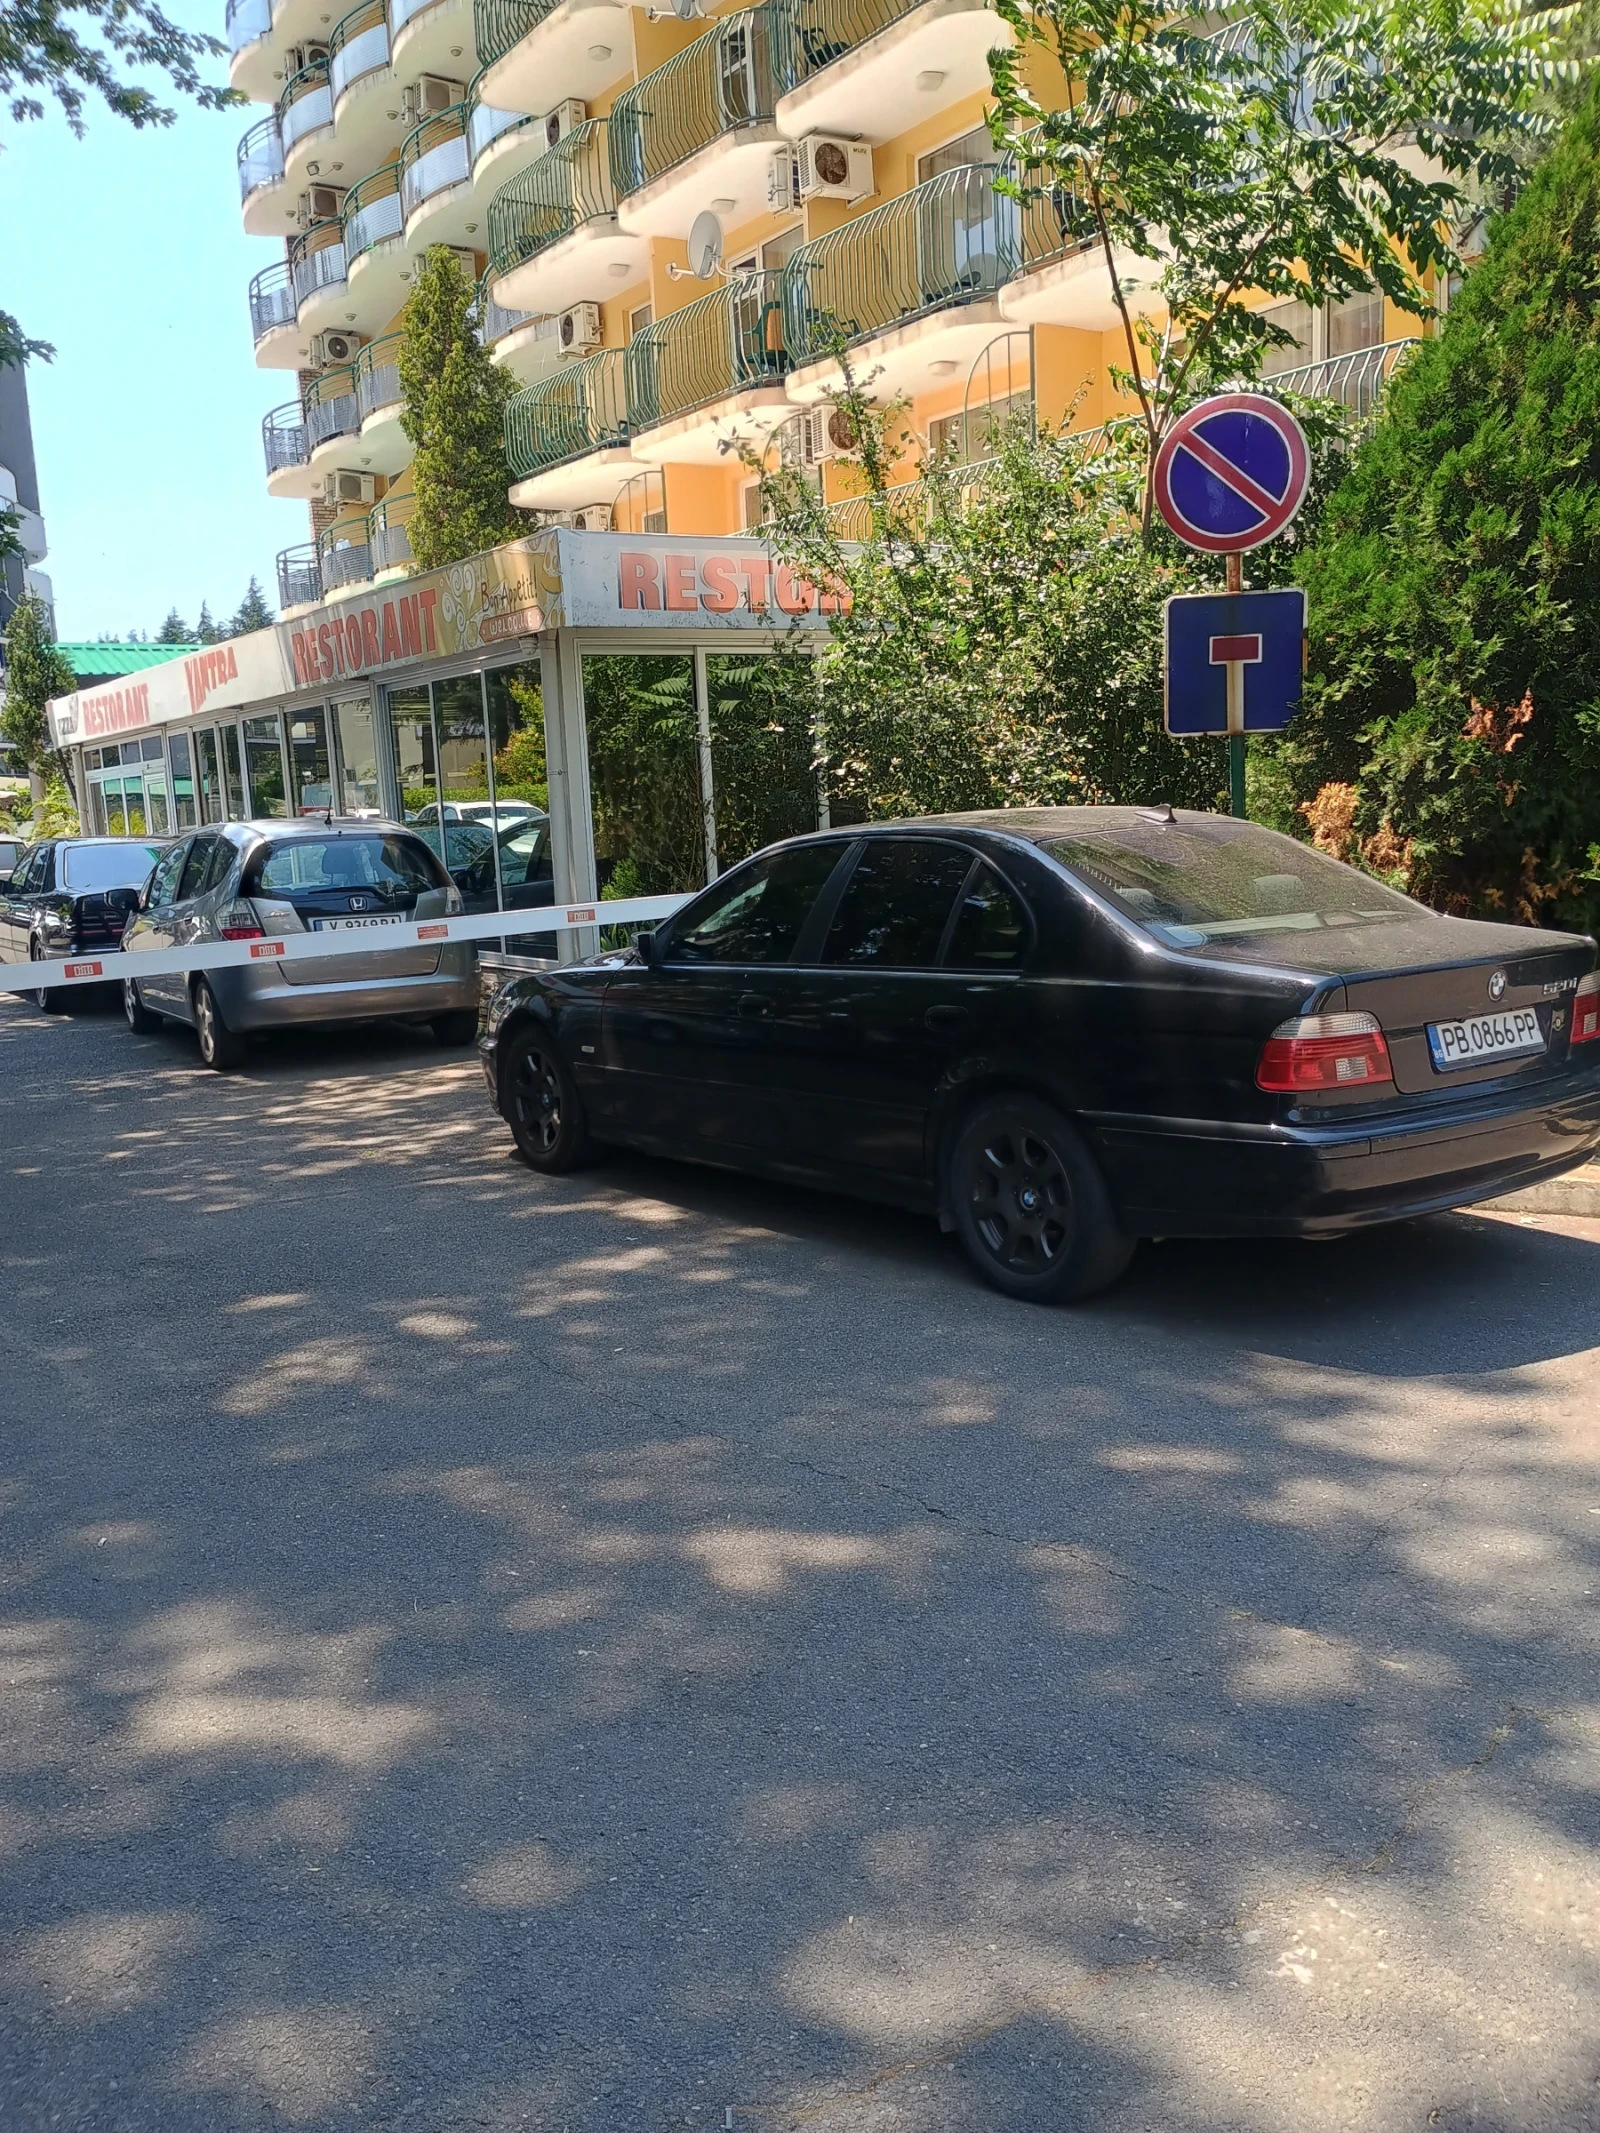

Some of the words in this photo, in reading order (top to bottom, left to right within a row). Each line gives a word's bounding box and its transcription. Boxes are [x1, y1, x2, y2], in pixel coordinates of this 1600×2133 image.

[481, 581, 499, 612] Bon
[501, 564, 538, 613] Appetit!
[618, 552, 854, 616] RESTOR
[291, 587, 438, 686] RESTORANT
[184, 646, 239, 714] YANTRA
[83, 683, 150, 736] RESTORANT
[1433, 1048, 1444, 1059] BG
